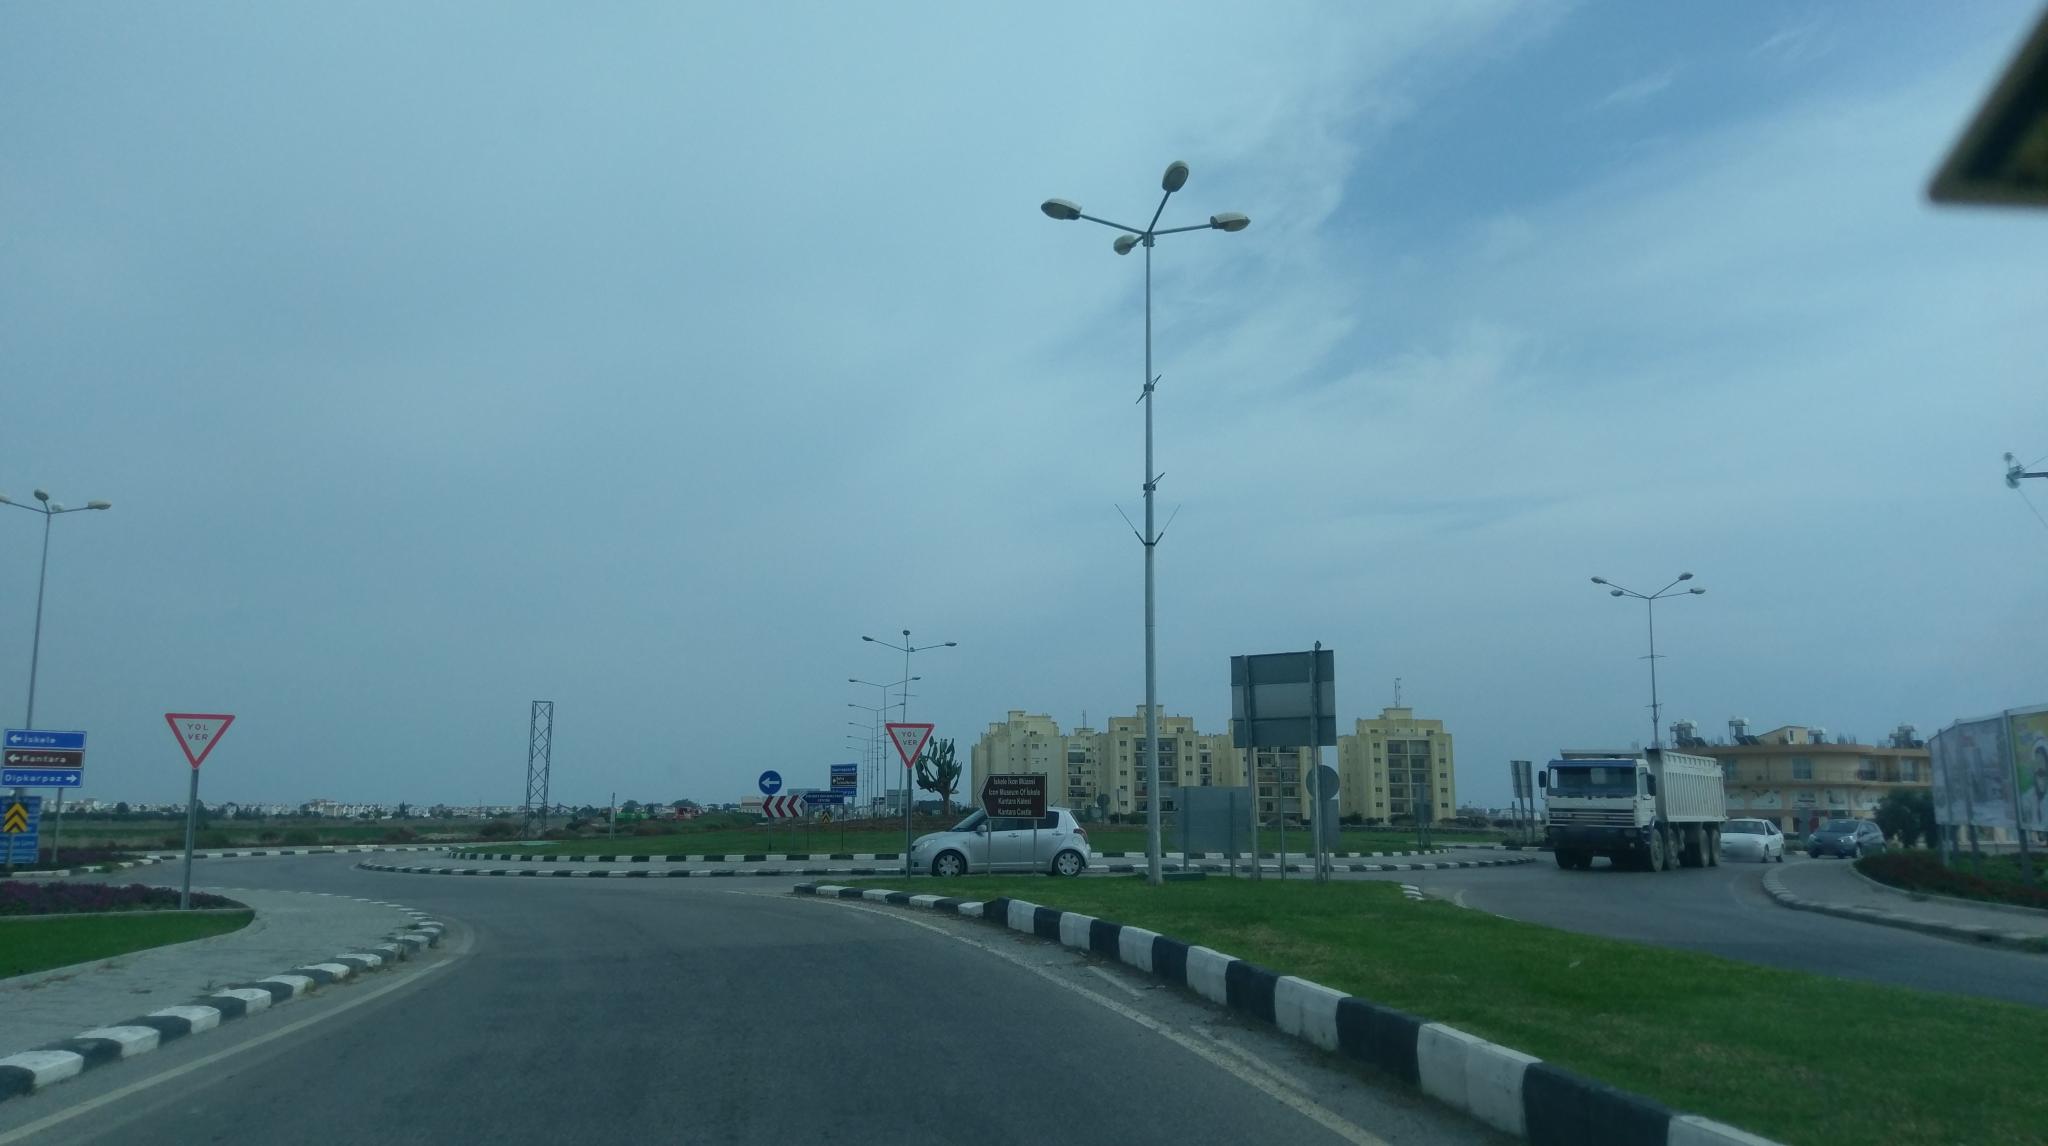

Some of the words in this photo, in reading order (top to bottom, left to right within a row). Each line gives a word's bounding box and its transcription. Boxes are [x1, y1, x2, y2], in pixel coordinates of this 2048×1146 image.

[187, 723, 209, 731] YOL
[188, 733, 209, 741] VER
[22, 754, 67, 763] Kantara
[5, 774, 63, 783] Dipkarpaz
